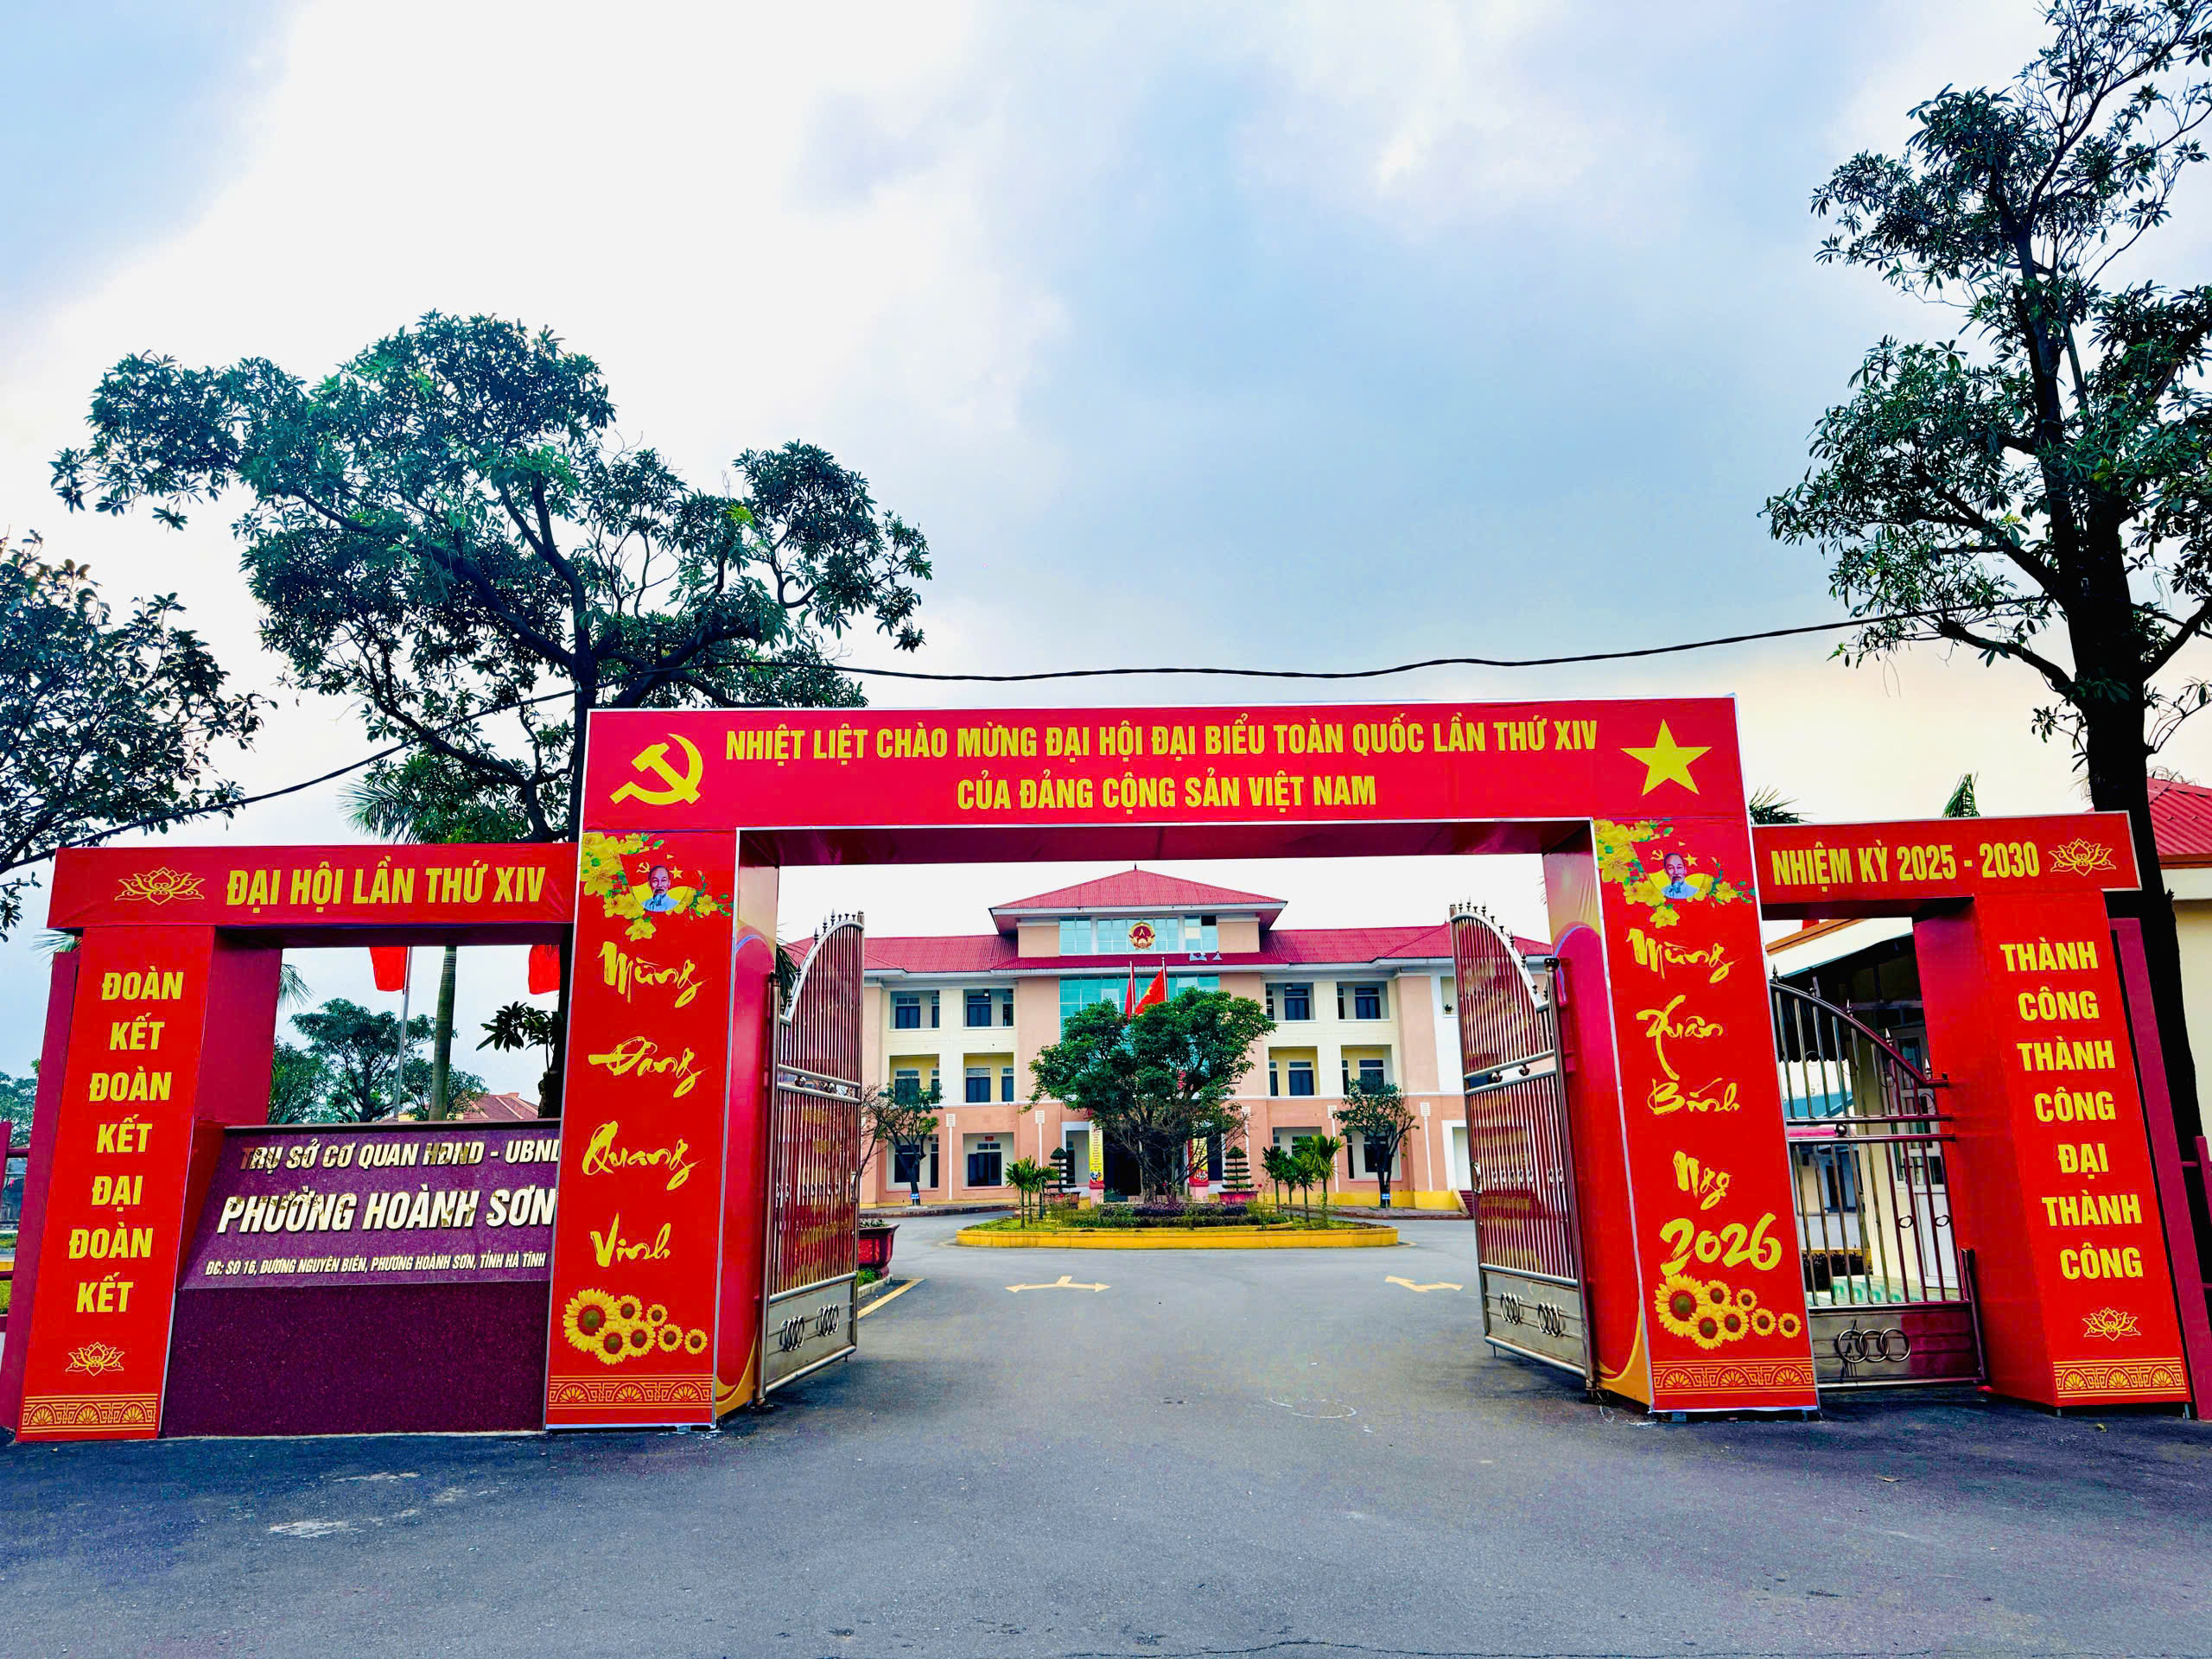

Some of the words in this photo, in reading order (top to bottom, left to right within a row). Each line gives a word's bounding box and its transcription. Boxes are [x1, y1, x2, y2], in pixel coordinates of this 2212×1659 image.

[725, 723, 805, 766] NHIỆT
[813, 722, 868, 766] LIỆT
[876, 721, 948, 759] CHÀO
[957, 721, 1037, 758] MỪNG
[1045, 727, 1090, 763] ĐẠI
[1099, 720, 1143, 762] HỘI
[1150, 725, 1196, 762] ĐẠI
[1205, 712, 1266, 755] BIỂU
[1273, 717, 1344, 754] TOÀN
[1352, 712, 1425, 757] QUỐC
[1433, 711, 1486, 753] LẦN
[1492, 715, 1548, 751] THỨ
[1553, 720, 1598, 751] XIV
[957, 769, 1012, 810] CỦA
[1019, 768, 1094, 810] ĐẢNG
[1102, 771, 1176, 813] CỘNG
[1185, 766, 1240, 808] SẢN
[1247, 770, 1305, 813] VIỆT
[1313, 775, 1376, 806] NAM
[226, 869, 282, 914] ĐẠI
[289, 861, 344, 913] HỘI
[353, 855, 416, 905] LẦN
[425, 859, 489, 904] THỨ
[493, 867, 546, 903] XIV
[1770, 841, 1853, 893] NHIỆM
[1857, 839, 1888, 883] KỲ
[1896, 844, 1957, 881] 2025
[1979, 841, 2040, 879] 2030
[1999, 937, 2099, 972] THÀNH
[101, 965, 184, 1001] ĐOÀN
[2018, 986, 2100, 1021] CÔNG
[109, 1012, 166, 1051] KẾT
[1636, 995, 1724, 1083] Xuân
[2016, 1035, 2116, 1071] THÀNH
[88, 1065, 172, 1102] ĐOÀN
[2034, 1086, 2116, 1122] CÔNG
[96, 1113, 153, 1154] KẾT
[240, 1146, 283, 1174] TRỤ
[285, 1137, 321, 1169] SỞ
[322, 1141, 357, 1168] CƠ
[358, 1142, 420, 1170] QUAN
[422, 1141, 485, 1166] HĐND
[582, 1120, 697, 1191] Quang
[2057, 1142, 2109, 1179] ĐẠI
[91, 1175, 143, 1212] ĐẠI
[216, 1185, 358, 1234] PHƯỜNG
[361, 1183, 480, 1230] HOÀNH
[485, 1184, 556, 1230] SƠN
[2041, 1189, 2143, 1227] THÀNH
[68, 1221, 154, 1260] ĐOÀN
[589, 1212, 671, 1268] Vinh
[1659, 1212, 1783, 1274] 2026
[243, 1260, 257, 1276] 16,
[504, 1250, 519, 1268] HÀ
[2059, 1242, 2144, 1280] CÔNG
[75, 1271, 134, 1313] KẾT
